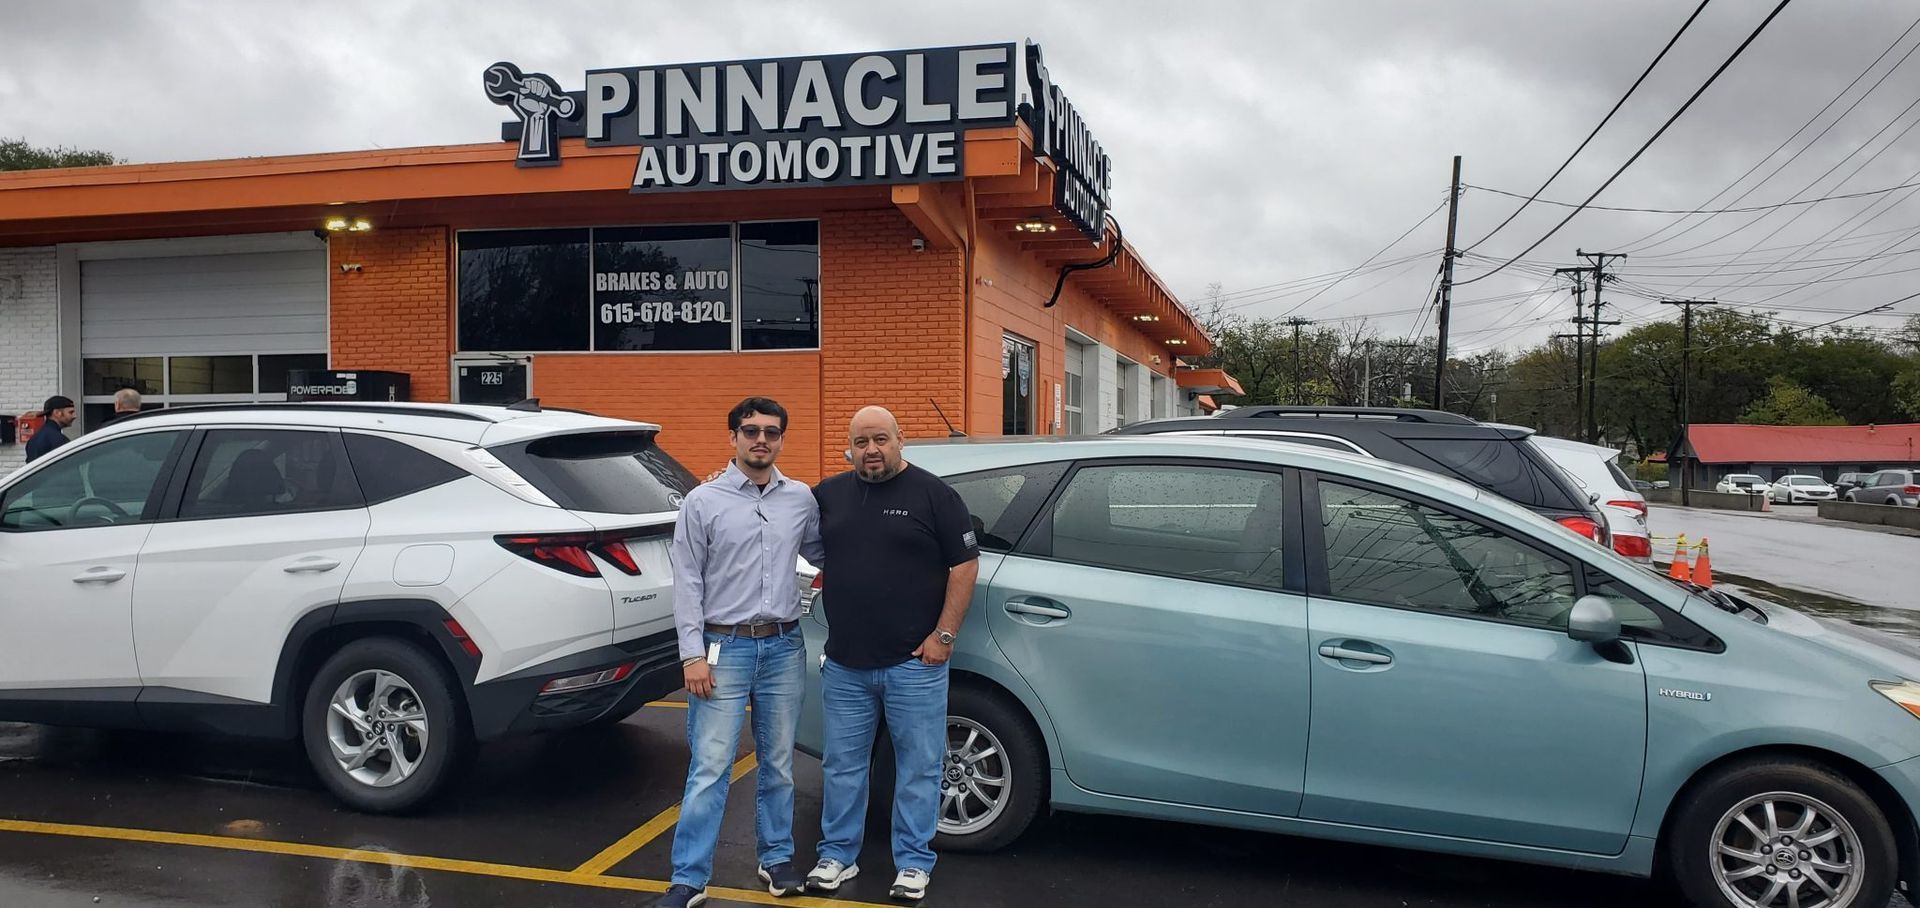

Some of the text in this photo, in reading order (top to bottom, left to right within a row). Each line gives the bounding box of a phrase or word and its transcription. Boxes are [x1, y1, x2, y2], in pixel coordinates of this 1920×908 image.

[587, 48, 1007, 138] PINNACLE
[1056, 85, 1112, 210] PINNACLE
[633, 132, 956, 186] AUTOMOTIVE
[596, 270, 728, 291] BRAKES & AUTO
[601, 301, 725, 323] 615-678-8120
[482, 372, 502, 384] 225
[290, 385, 349, 395] POWERADE
[1659, 688, 1704, 700] HYBRID
